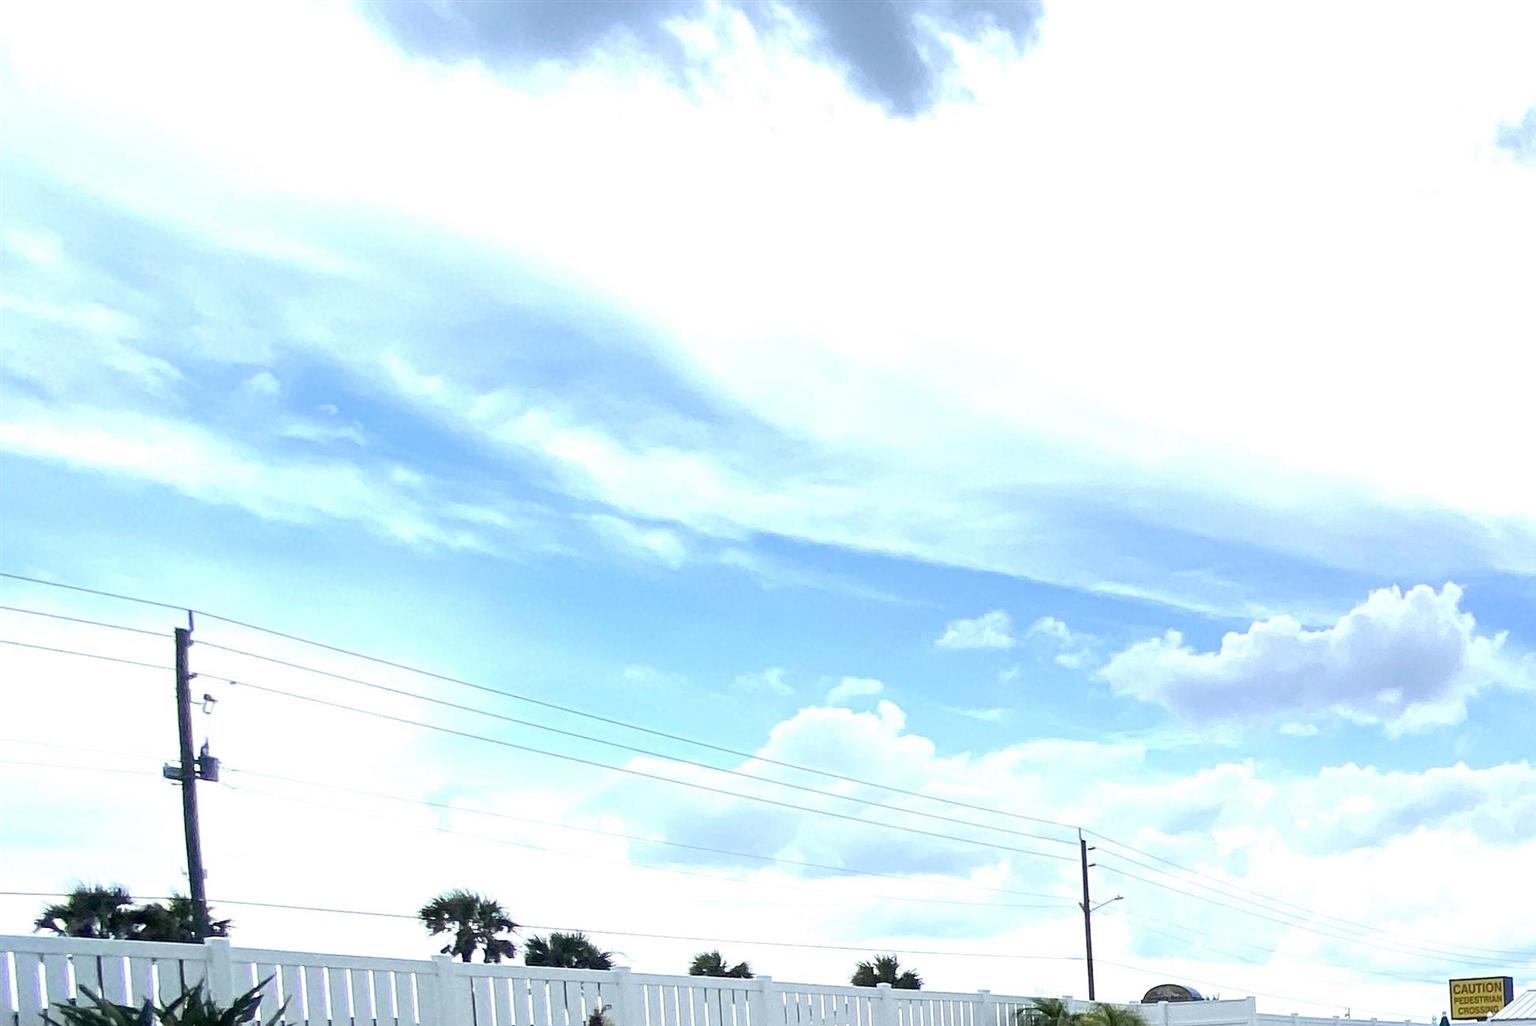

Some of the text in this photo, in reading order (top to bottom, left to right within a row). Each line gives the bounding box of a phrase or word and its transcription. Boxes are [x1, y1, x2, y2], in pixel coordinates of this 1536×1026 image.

[1453, 982, 1502, 994] CAUTION
[1454, 995, 1503, 1004] PEDESTRIAN
[1458, 1005, 1500, 1015] CROSSING
